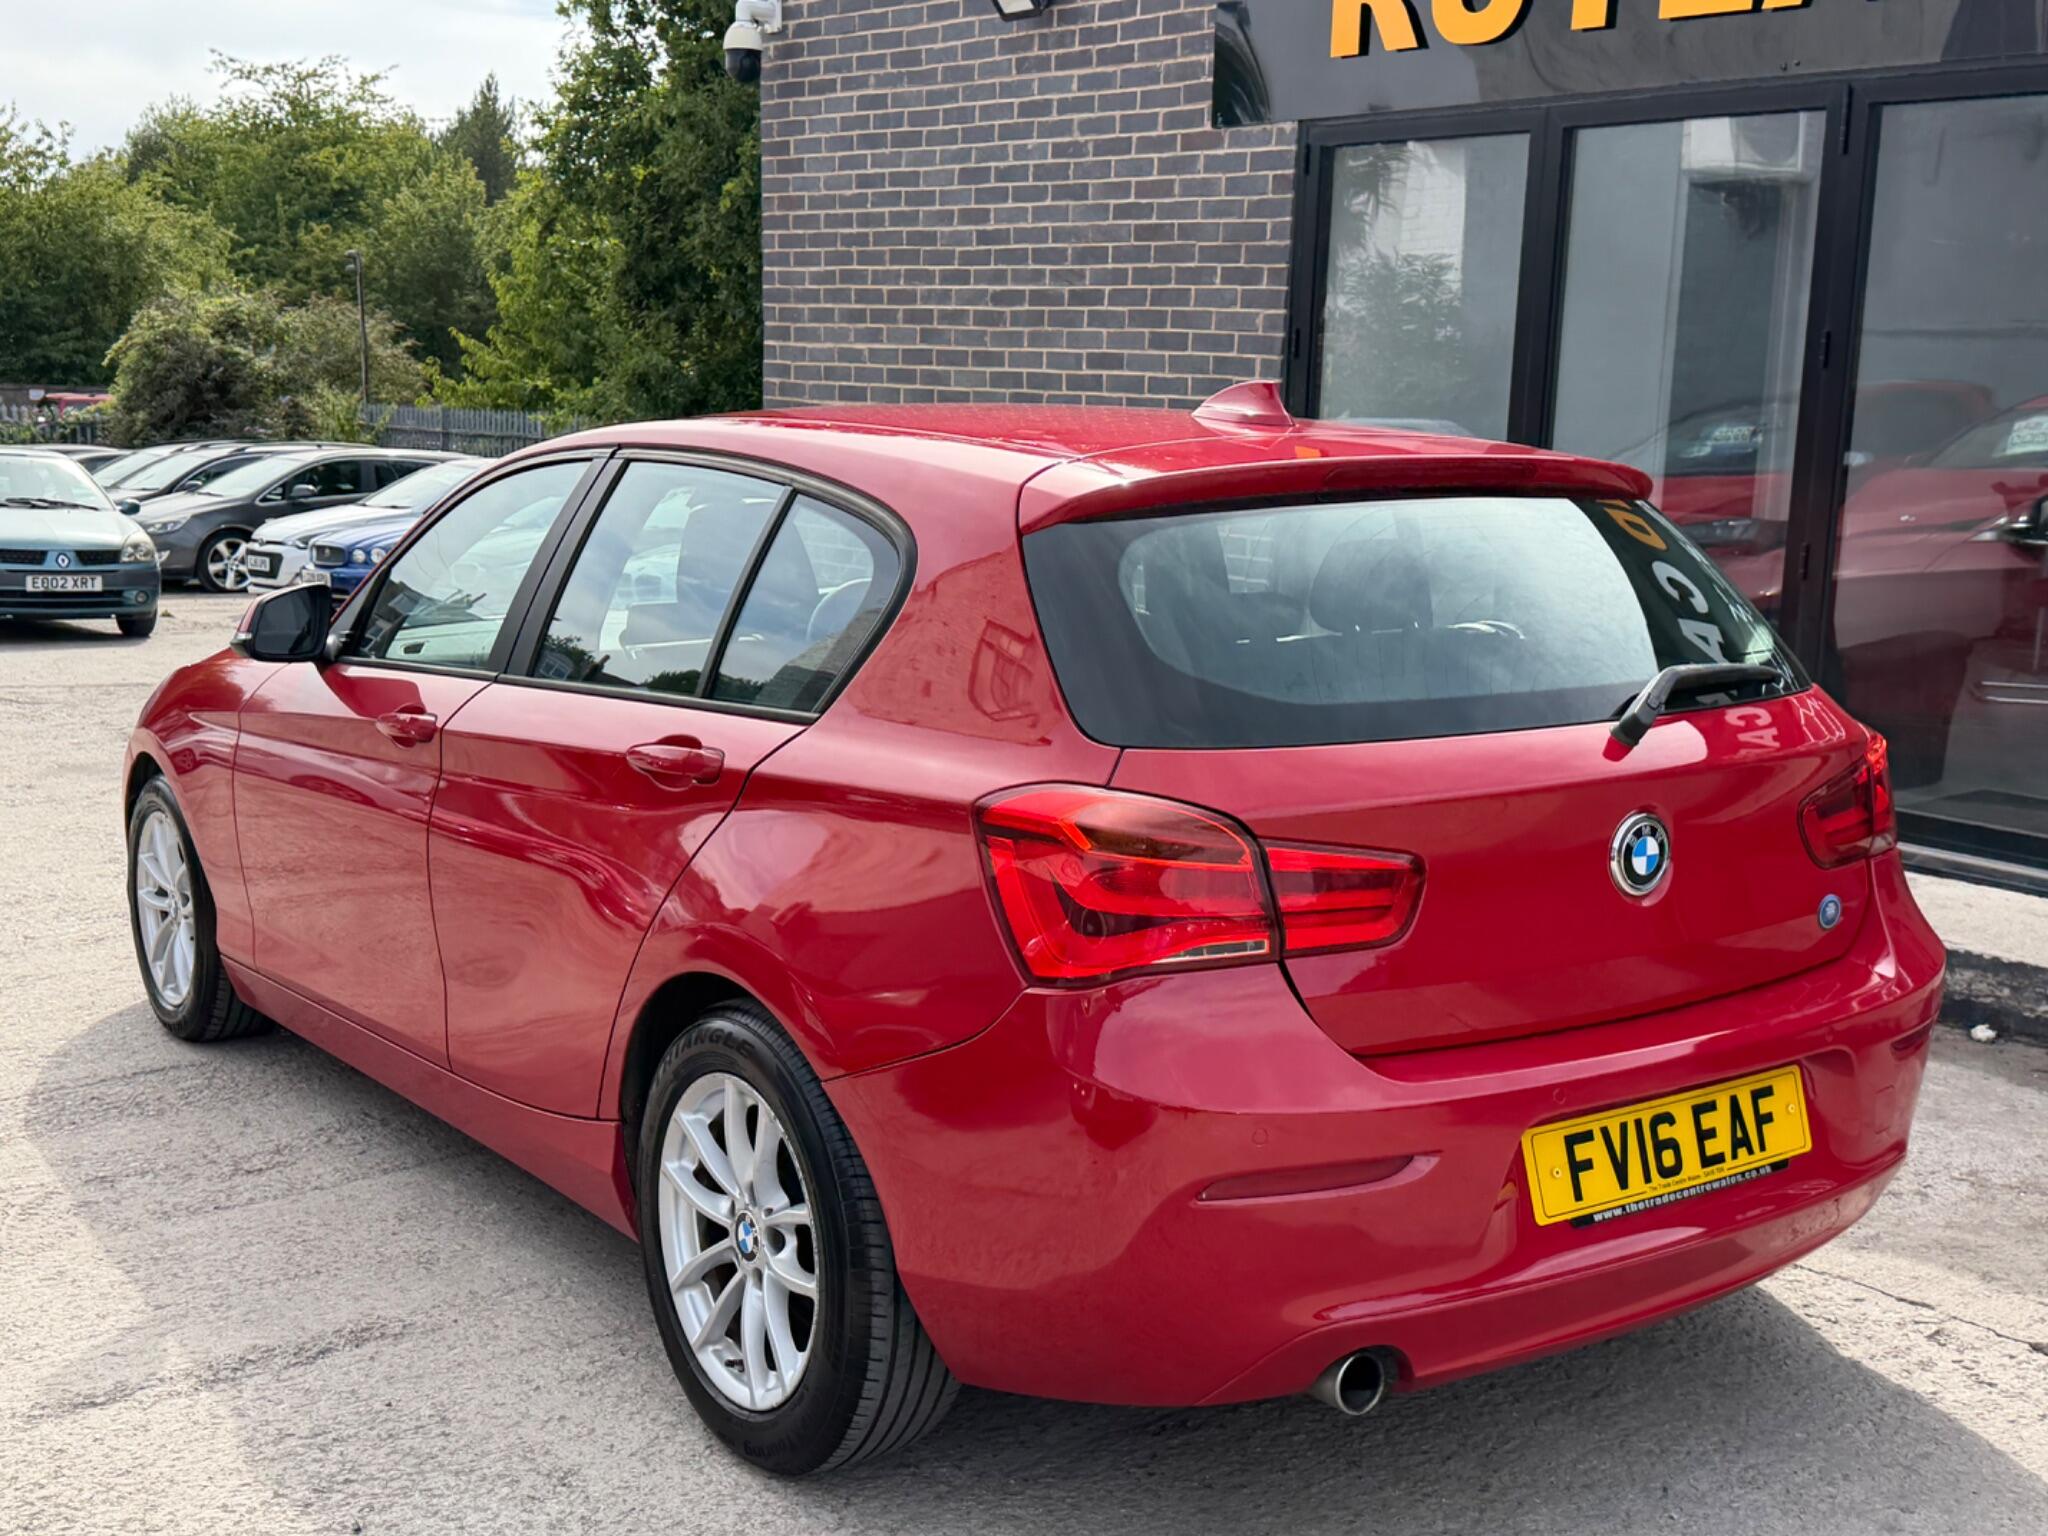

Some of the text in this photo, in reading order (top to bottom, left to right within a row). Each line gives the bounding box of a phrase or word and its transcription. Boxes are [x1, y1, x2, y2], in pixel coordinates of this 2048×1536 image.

[71, 577, 97, 589] XRT
[1564, 1085, 1774, 1202] FV16 EAF
